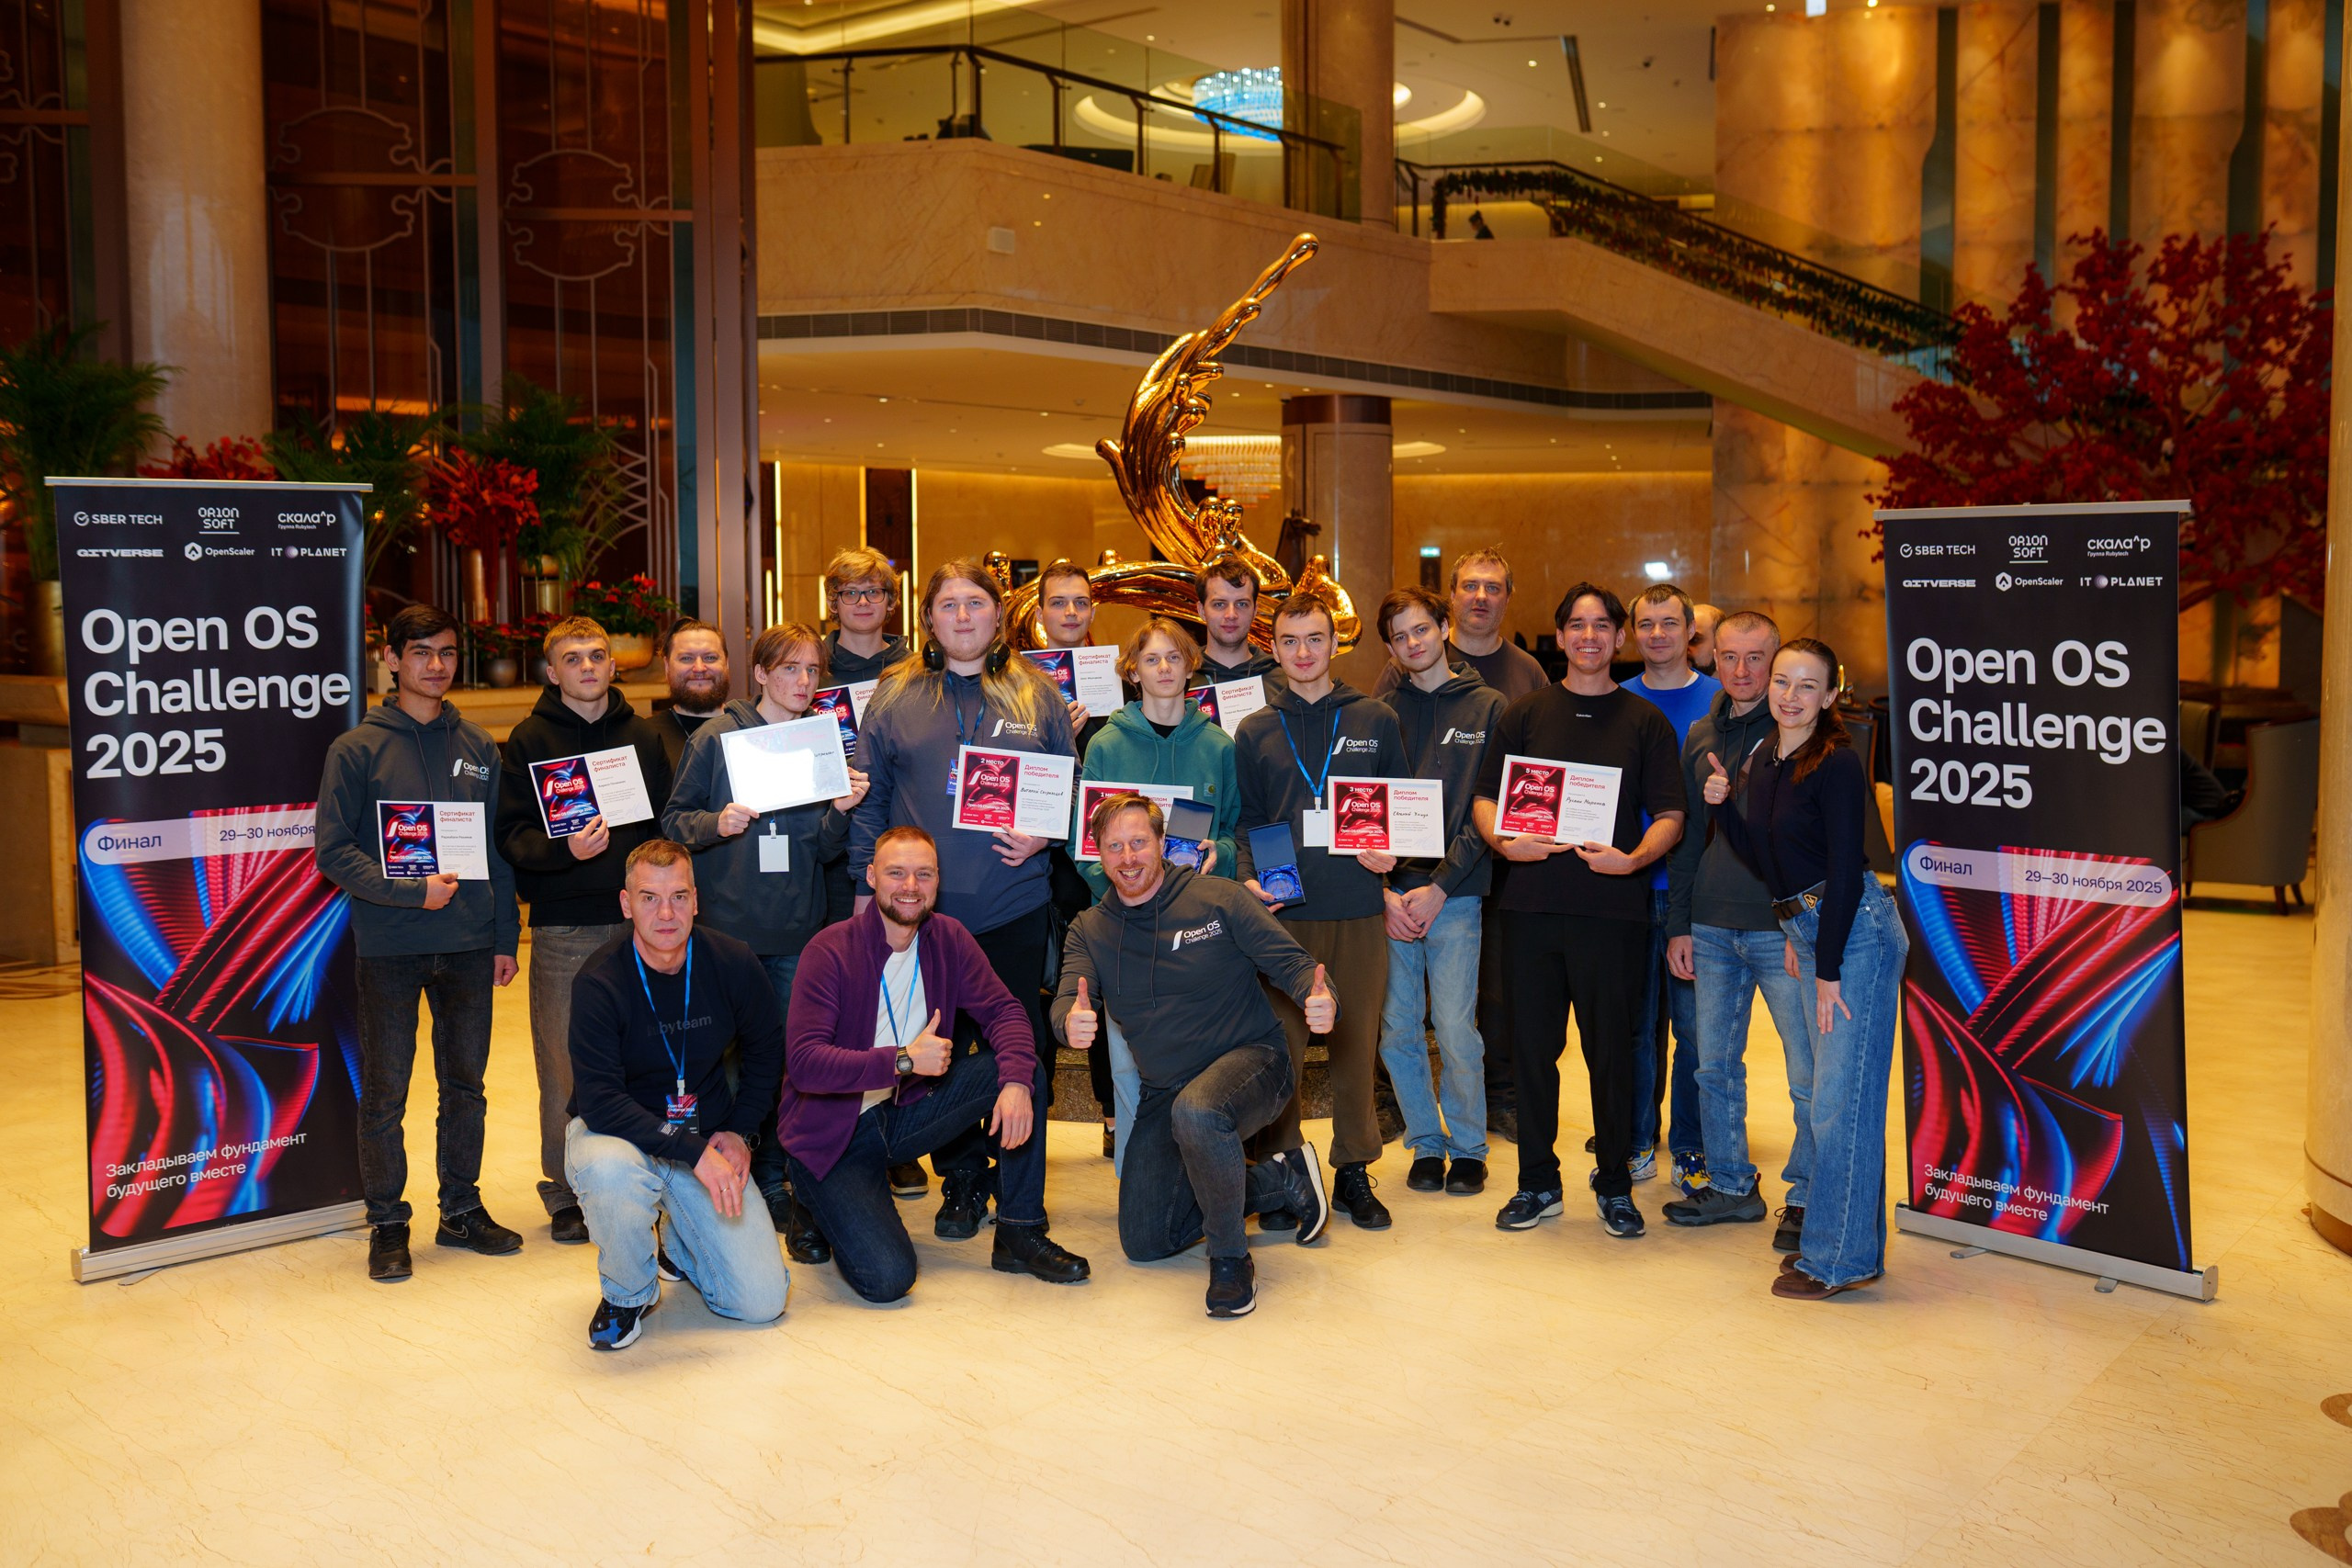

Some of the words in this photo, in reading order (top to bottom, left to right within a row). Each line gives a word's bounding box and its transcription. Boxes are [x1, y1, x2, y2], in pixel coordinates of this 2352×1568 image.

[92, 514, 126, 524] SBER
[129, 515, 163, 525] TECH
[203, 519, 235, 529] SOFT
[77, 549, 164, 557] GITVERSE
[205, 547, 255, 557] OpenScaler
[271, 548, 283, 556] IT
[301, 548, 347, 557] PLANET
[1915, 545, 1943, 555] SBER
[1946, 545, 1975, 555] TECH
[2013, 547, 2044, 558] SOFT
[1903, 579, 1976, 588] GITVERSE
[2015, 577, 2064, 588] OpenScaler
[2080, 577, 2092, 586] IT
[2111, 577, 2163, 586] PLANET
[81, 608, 228, 664] Open
[244, 606, 319, 650] OS
[1906, 637, 2036, 694] Open
[2052, 640, 2130, 688] OS
[84, 668, 351, 719] Challenge
[1221, 686, 1254, 695] Сертификат
[1222, 692, 1252, 700] финалиста
[1909, 698, 2166, 765] Challenge
[86, 728, 226, 779] 2025
[592, 756, 627, 766] Сертификат
[463, 762, 479, 773] Open
[594, 763, 625, 772] финалиста
[981, 774, 998, 782] Open
[1910, 758, 2032, 809] 2025
[554, 781, 572, 790] Open
[1525, 783, 1543, 792] Open
[1569, 782, 1605, 790] победителя
[267, 824, 315, 838] ноября
[98, 835, 162, 852] Финал
[1919, 856, 1972, 875] Финал
[2073, 876, 2122, 892] ноября
[2126, 880, 2162, 893] 2025
[1184, 927, 1206, 938] Open
[1207, 920, 1220, 931] OS
[1185, 934, 1209, 944] Challenge
[1209, 929, 1222, 937] 2025
[105, 1149, 217, 1177] Закладываем
[221, 1133, 307, 1160] фундамент
[106, 1173, 186, 1199] будущего
[190, 1163, 246, 1183] вместе
[1924, 1164, 2020, 1196] Закладываем
[2024, 1186, 2109, 1214] фундамент
[1925, 1183, 1992, 1209] будущего
[1996, 1200, 2047, 1221] вместе
